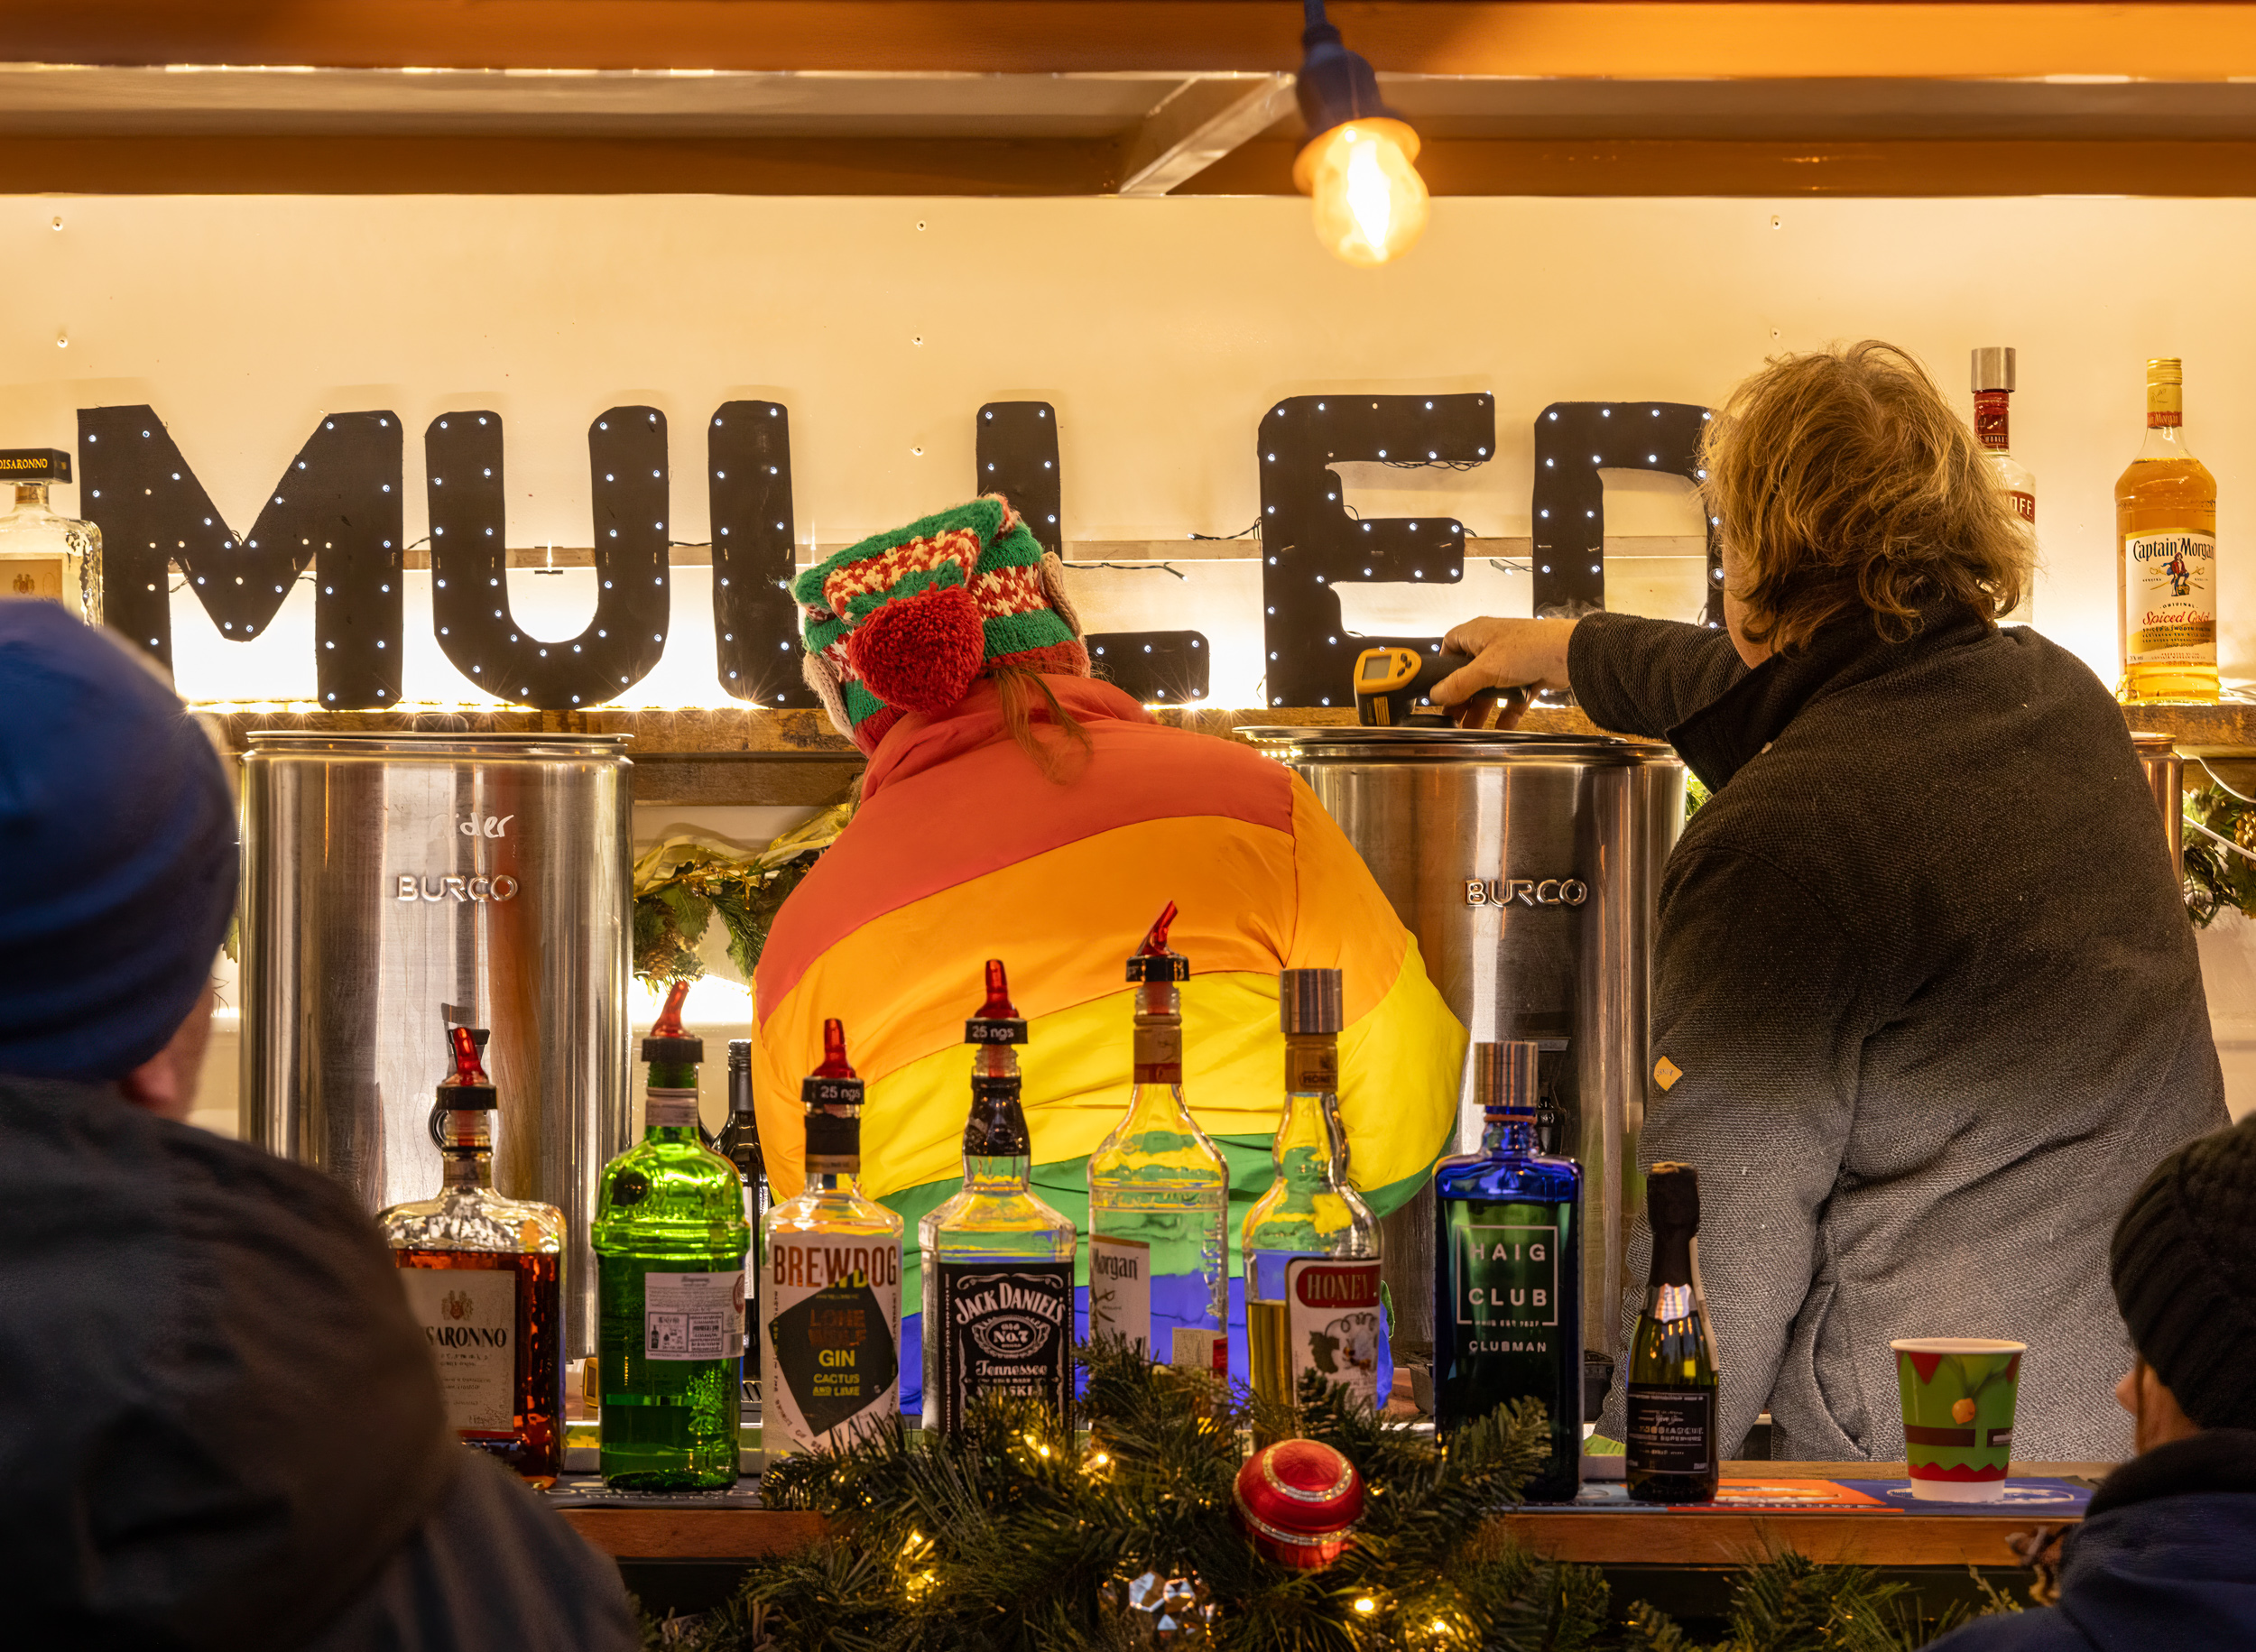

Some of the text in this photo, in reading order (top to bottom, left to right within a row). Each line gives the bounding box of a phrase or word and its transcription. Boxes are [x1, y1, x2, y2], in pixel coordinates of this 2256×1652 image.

[2133, 538, 2214, 562] Captain Morgan
[2142, 610, 2211, 625] Spiced Gold
[457, 812, 514, 838] der
[397, 873, 518, 902] BURCO
[1465, 879, 1588, 907] BURCO
[972, 1025, 988, 1038] 25
[820, 1086, 837, 1098] 25
[1470, 1243, 1546, 1261] HAIG
[773, 1245, 897, 1288] BREWDOG
[1468, 1288, 1547, 1306] CLUB
[955, 1290, 999, 1324] JACK
[425, 1325, 507, 1348] SARONNO
[1469, 1340, 1547, 1352] CLUBMAN
[818, 1349, 855, 1367] GIN
[975, 1360, 1048, 1376] Tennessee
[813, 1373, 860, 1384] CACTUS
